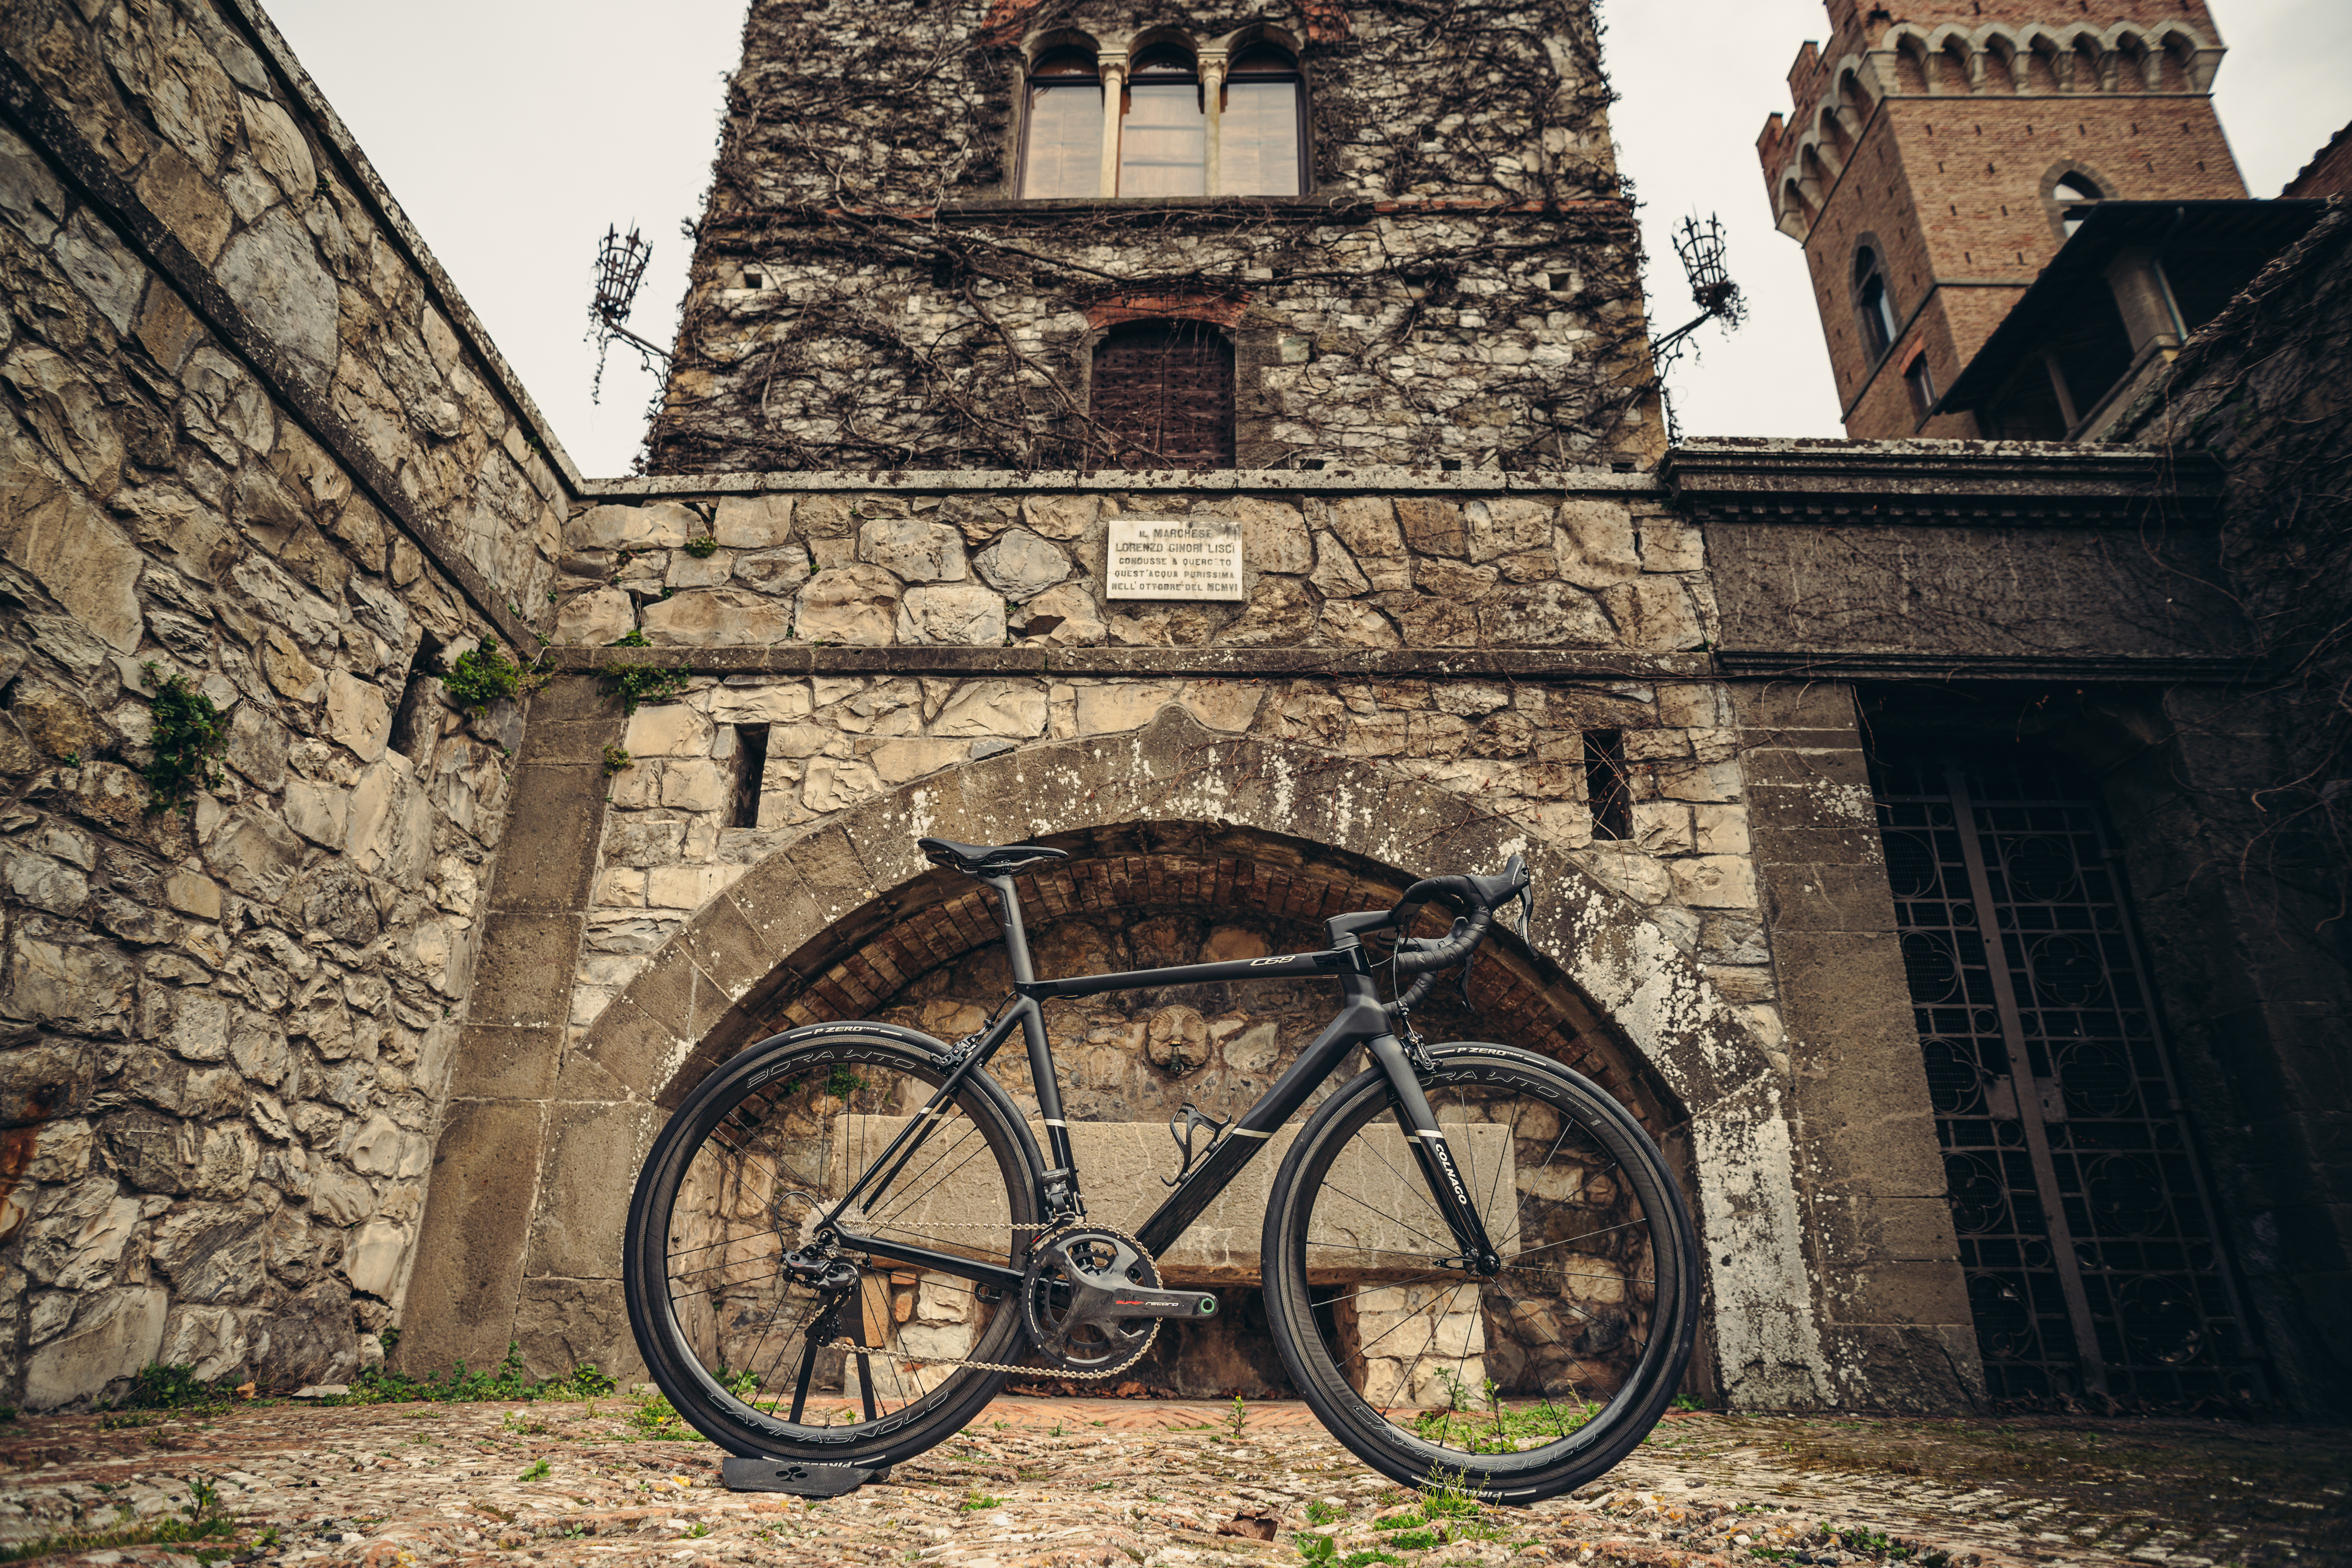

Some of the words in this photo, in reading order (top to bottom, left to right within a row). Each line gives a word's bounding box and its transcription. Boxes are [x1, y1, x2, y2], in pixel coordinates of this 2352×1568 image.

[1153, 529, 1212, 538] MARCHESE
[1115, 543, 1163, 552] LORENZO
[1169, 543, 1202, 553] GINORI
[1208, 543, 1235, 554] LISCI
[1115, 569, 1178, 578] QUEST'ACQUA
[1111, 581, 1137, 590] NELL'
[1207, 583, 1238, 591] MCMVI
[999, 892, 1008, 921] COLNAGO
[1250, 955, 1296, 967] C68
[1468, 1047, 1507, 1056] ZERO
[747, 1049, 834, 1088] BORA
[843, 1049, 916, 1069] WTO
[1486, 1072, 1560, 1098] WTO
[1435, 1143, 1467, 1205] COLNAGO
[707, 1389, 949, 1444] CAMPAGNOLO
[1352, 1405, 1597, 1472] CAMPAGNOLO
